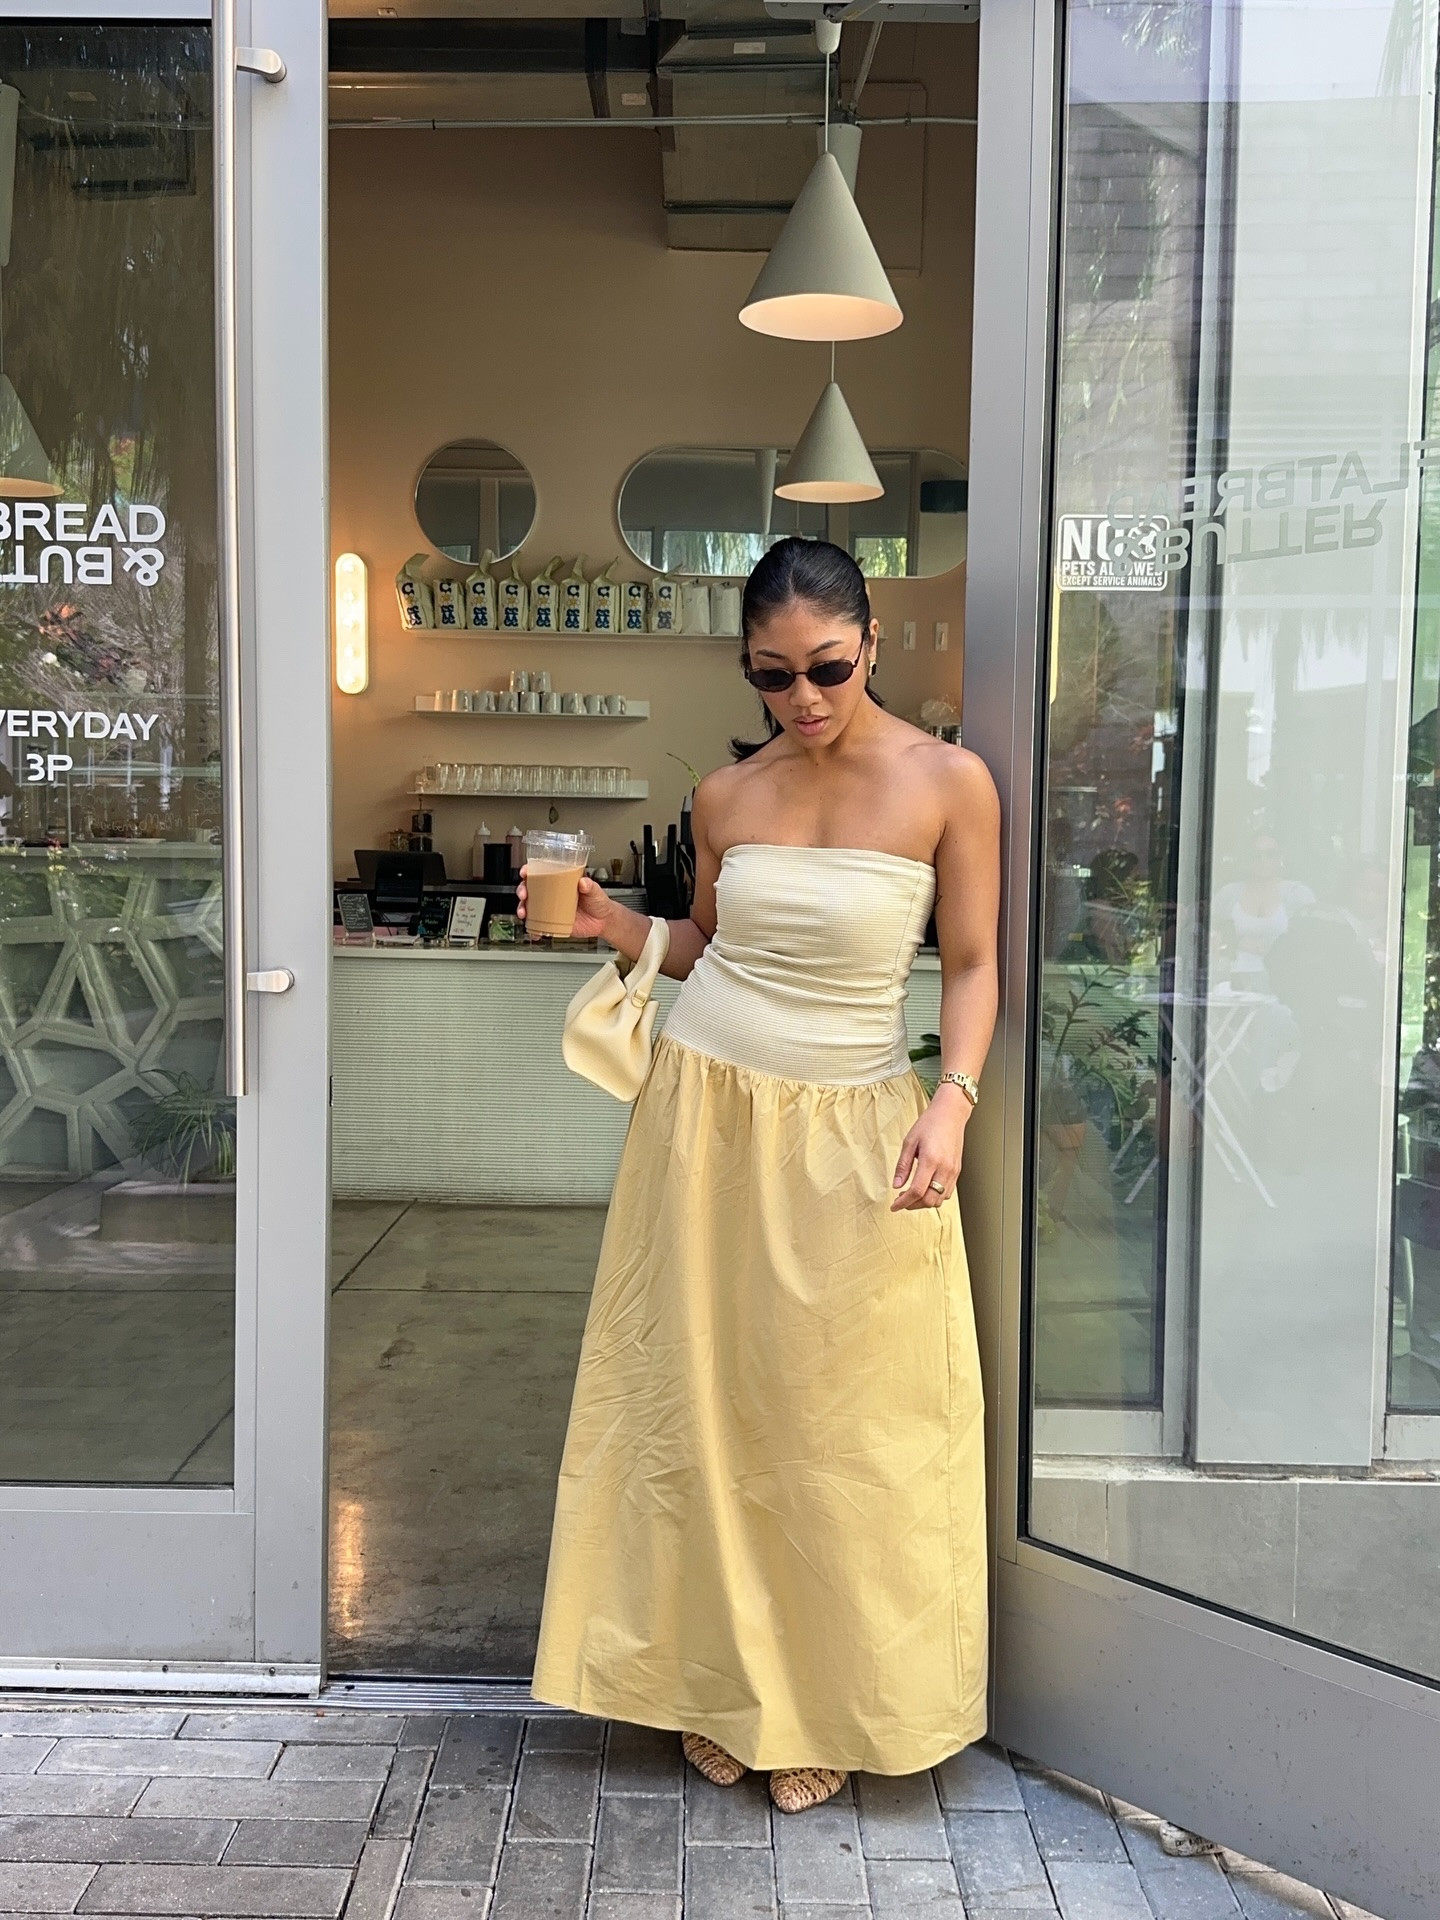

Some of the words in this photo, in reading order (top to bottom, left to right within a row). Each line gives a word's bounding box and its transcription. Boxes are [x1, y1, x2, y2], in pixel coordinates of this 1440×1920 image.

[121, 547, 165, 587] &
[1061, 560, 1096, 577] PETS
[1099, 560, 1163, 577] ALWE
[1062, 576, 1091, 587] EXCEPT
[1093, 576, 1126, 587] SERVICE
[1127, 576, 1163, 587] ANIMALS
